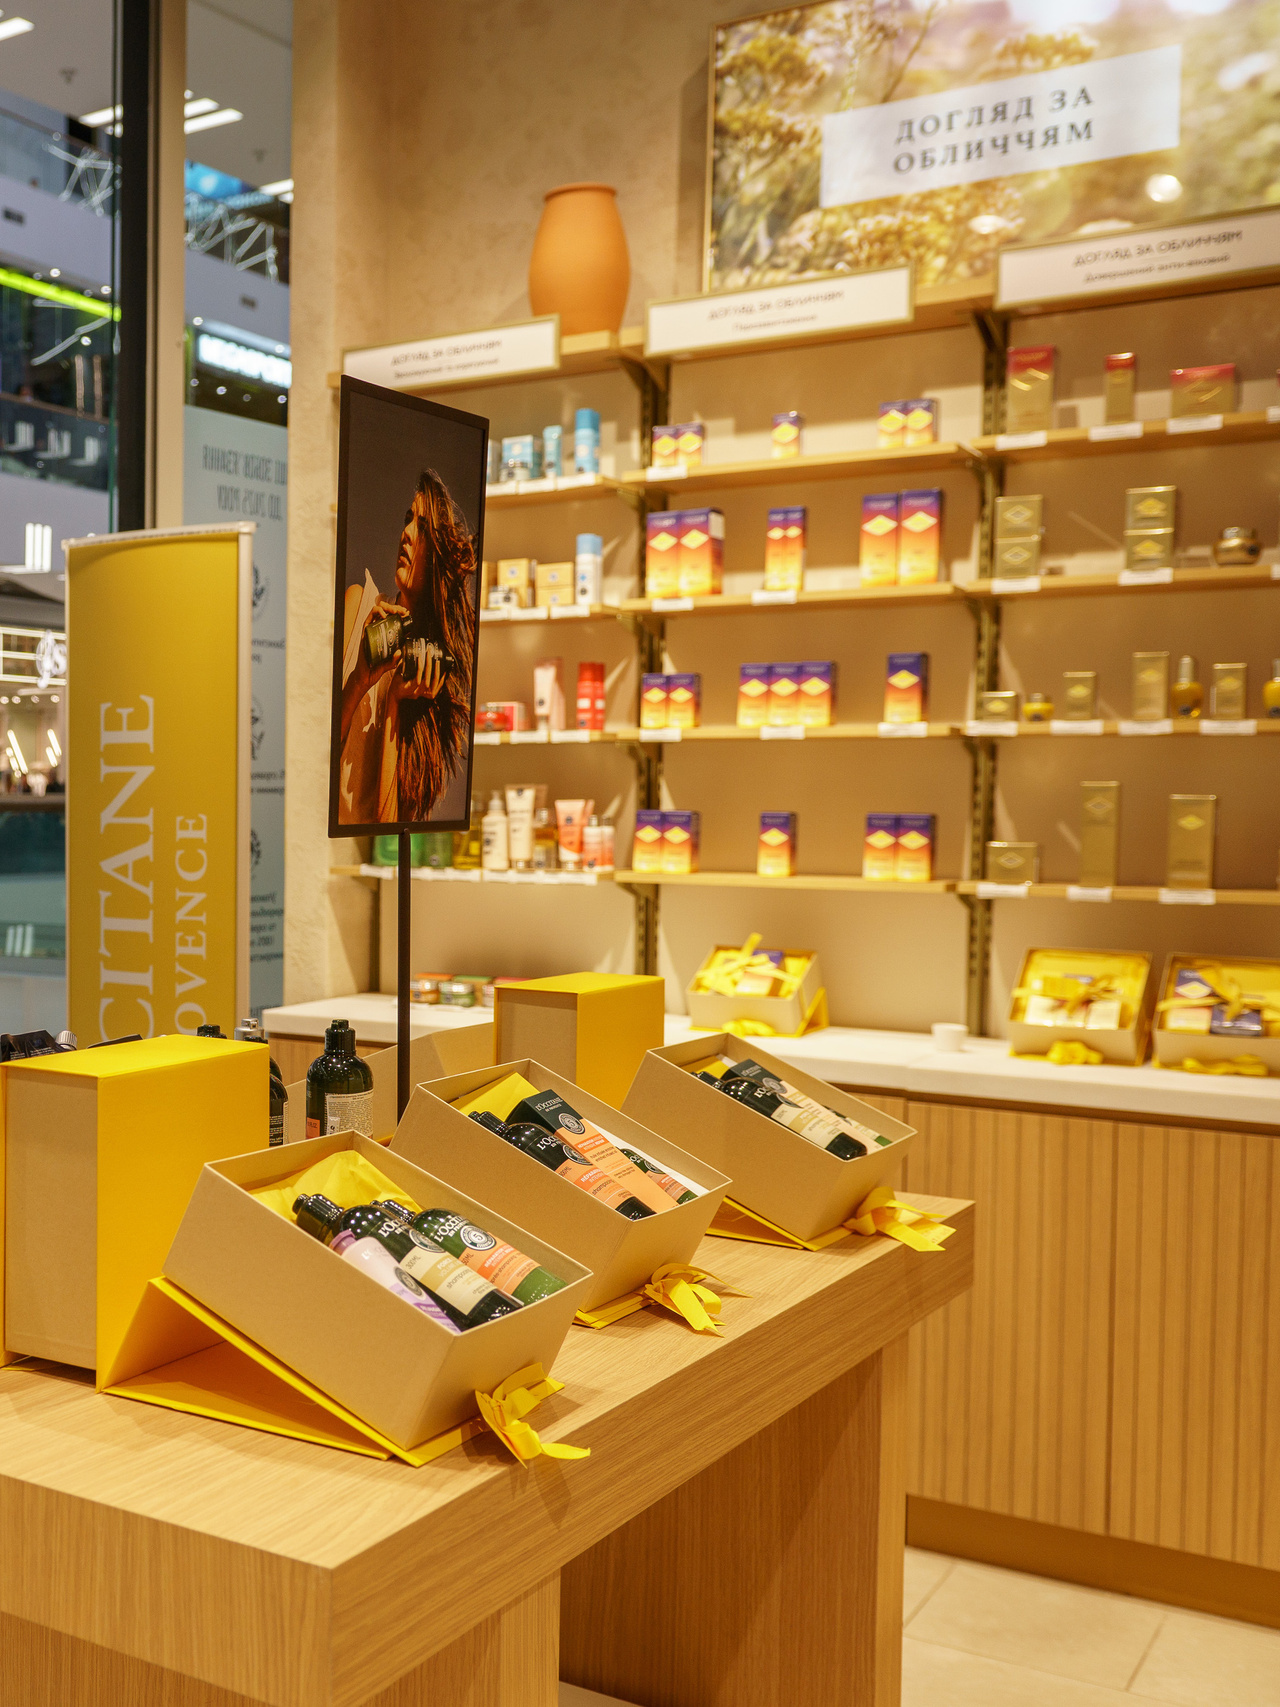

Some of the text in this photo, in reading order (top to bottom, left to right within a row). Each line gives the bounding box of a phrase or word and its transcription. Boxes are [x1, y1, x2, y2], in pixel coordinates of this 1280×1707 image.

[894, 87, 1094, 145] ДОГЛЯД ЗА
[893, 119, 1094, 175] ОБЛИЧЧЯМ
[99, 694, 155, 1043] CITANE
[175, 813, 207, 1036] OVENCE
[461, 1253, 474, 1266] 50ML
